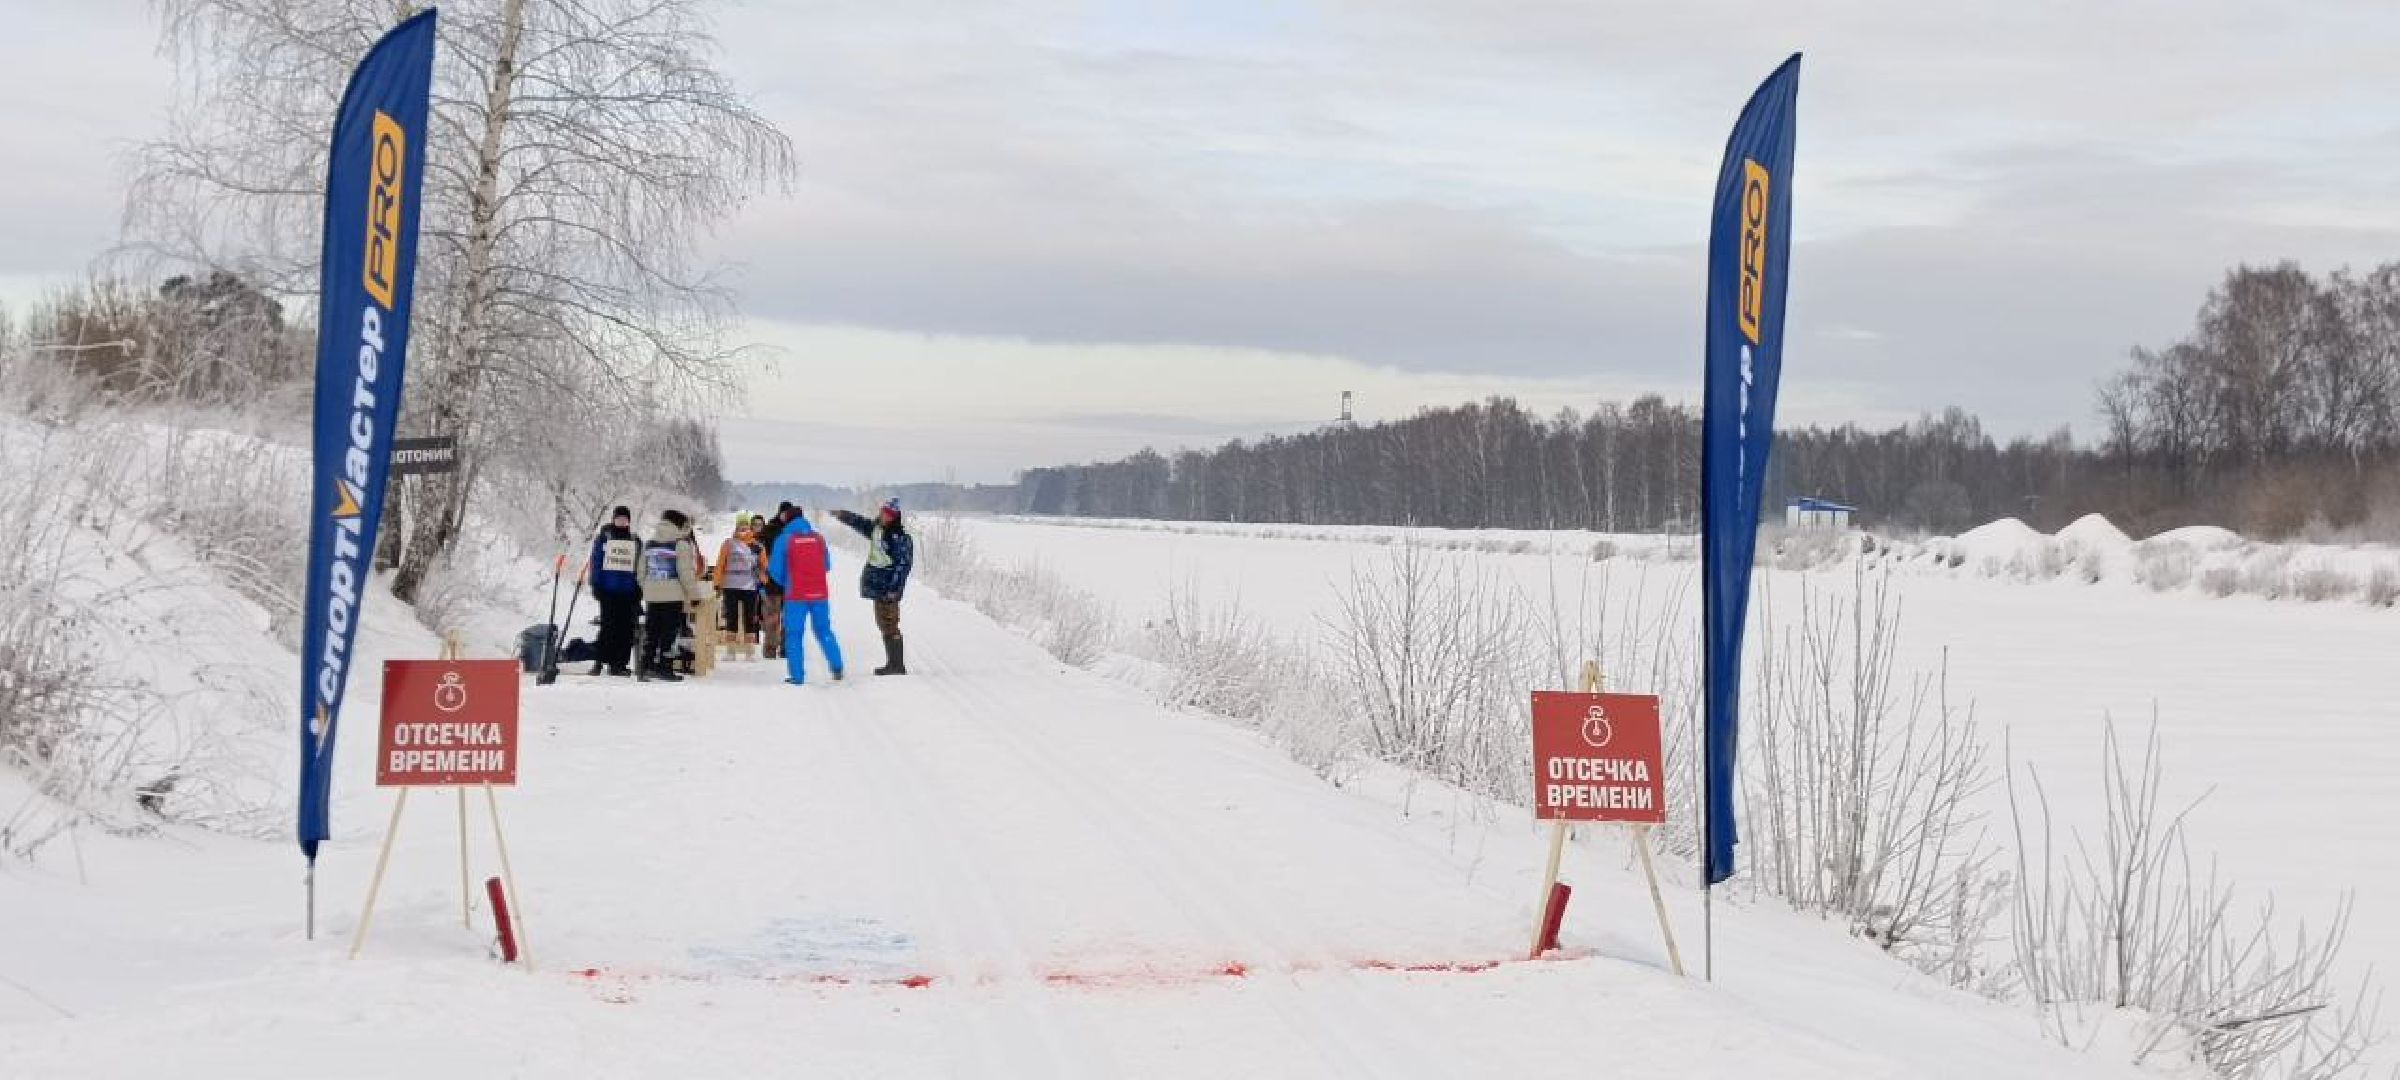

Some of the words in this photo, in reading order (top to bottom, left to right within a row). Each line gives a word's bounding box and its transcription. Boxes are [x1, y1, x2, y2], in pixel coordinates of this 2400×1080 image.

[368, 131, 398, 290] PRO
[1741, 178, 1764, 327] PRO
[394, 722, 502, 745] ОТСЕЧКА
[389, 749, 505, 773] ВРЕМЕНИ
[1548, 757, 1649, 781] ОТСЕЧКА
[1546, 784, 1652, 810] ВРЕМЕНИ
